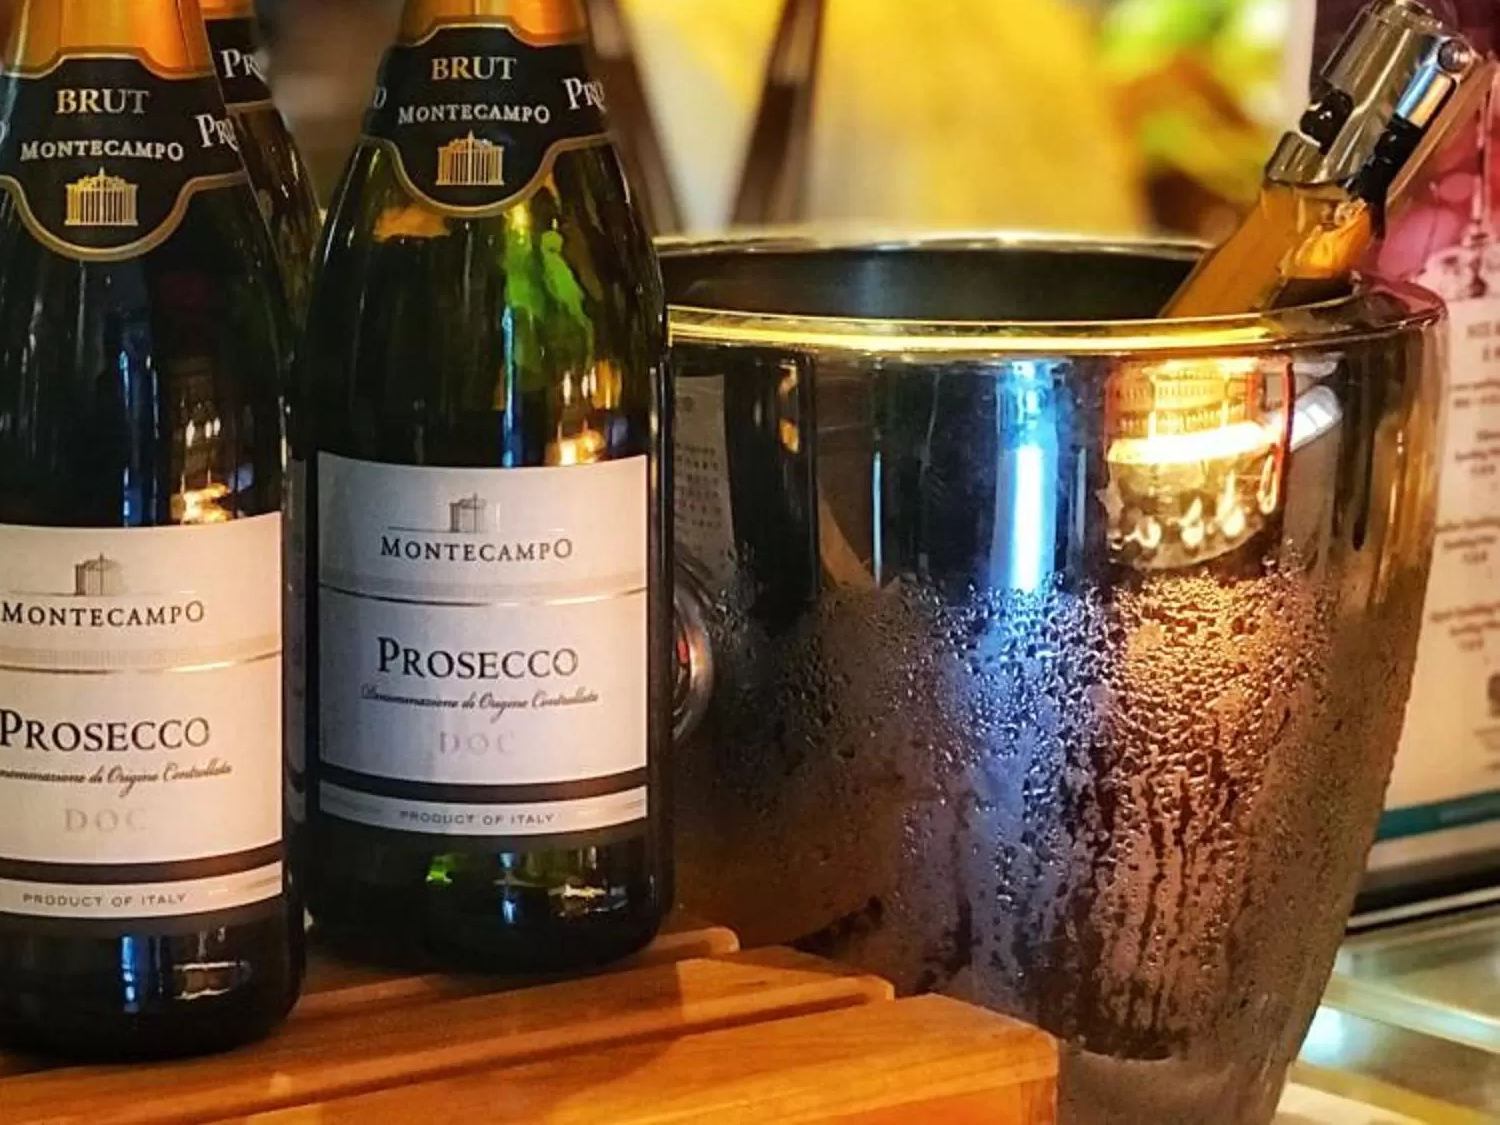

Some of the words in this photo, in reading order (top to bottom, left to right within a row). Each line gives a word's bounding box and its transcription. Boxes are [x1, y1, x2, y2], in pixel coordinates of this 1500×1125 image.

[432, 56, 517, 81] BRUT
[55, 88, 149, 114] BRUT
[398, 103, 550, 124] MONTECAMPO
[20, 140, 185, 162] MONTECAMPO
[380, 536, 573, 562] MONTECAMPO
[0, 600, 205, 627] MONTECAMPO
[377, 637, 579, 680] PROSECCO
[64, 808, 146, 832] DOC
[400, 810, 475, 825] PRODUCT
[483, 815, 504, 826] OF
[511, 814, 555, 825] ITALY
[23, 892, 103, 908] PRODUCT
[111, 896, 133, 908] OF
[142, 893, 187, 907] ITALY
